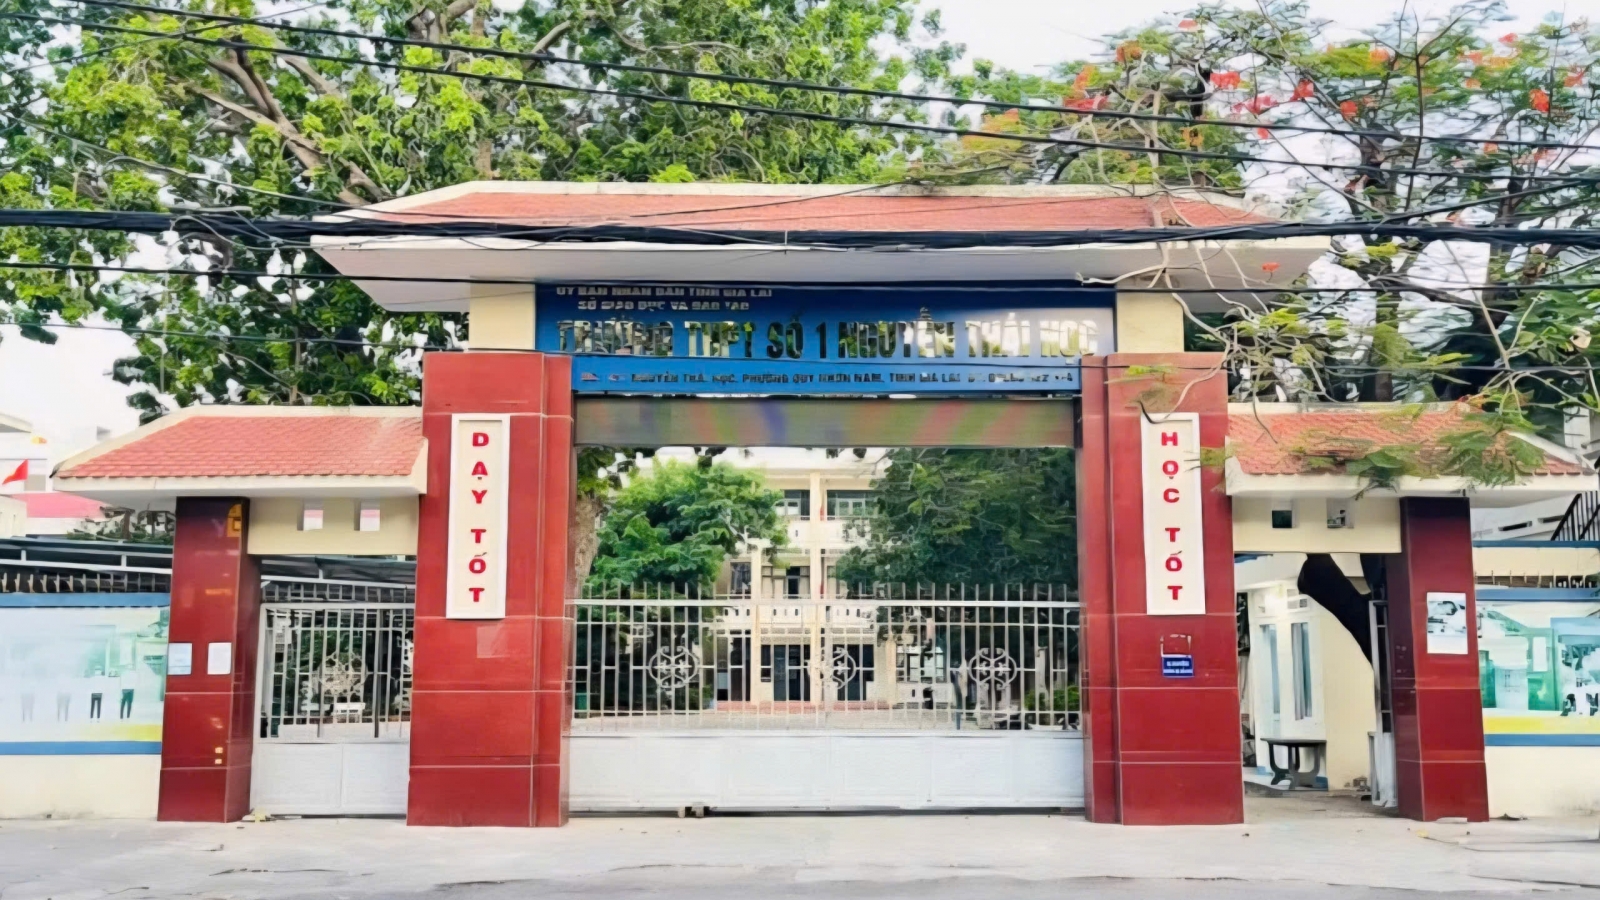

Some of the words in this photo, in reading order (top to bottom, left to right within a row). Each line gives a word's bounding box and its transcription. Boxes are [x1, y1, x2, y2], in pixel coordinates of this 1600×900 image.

[684, 321, 755, 358] THPT
[766, 311, 804, 359] SỐ
[815, 321, 827, 358] 1
[838, 306, 955, 358] NGUYỄN
[965, 312, 1031, 357] THÁI
[1040, 320, 1099, 365] HỌC
[471, 432, 489, 504] DẠY
[1161, 431, 1180, 503] HỌC
[468, 527, 488, 603] TỐT
[1165, 527, 1183, 601] TỐT
